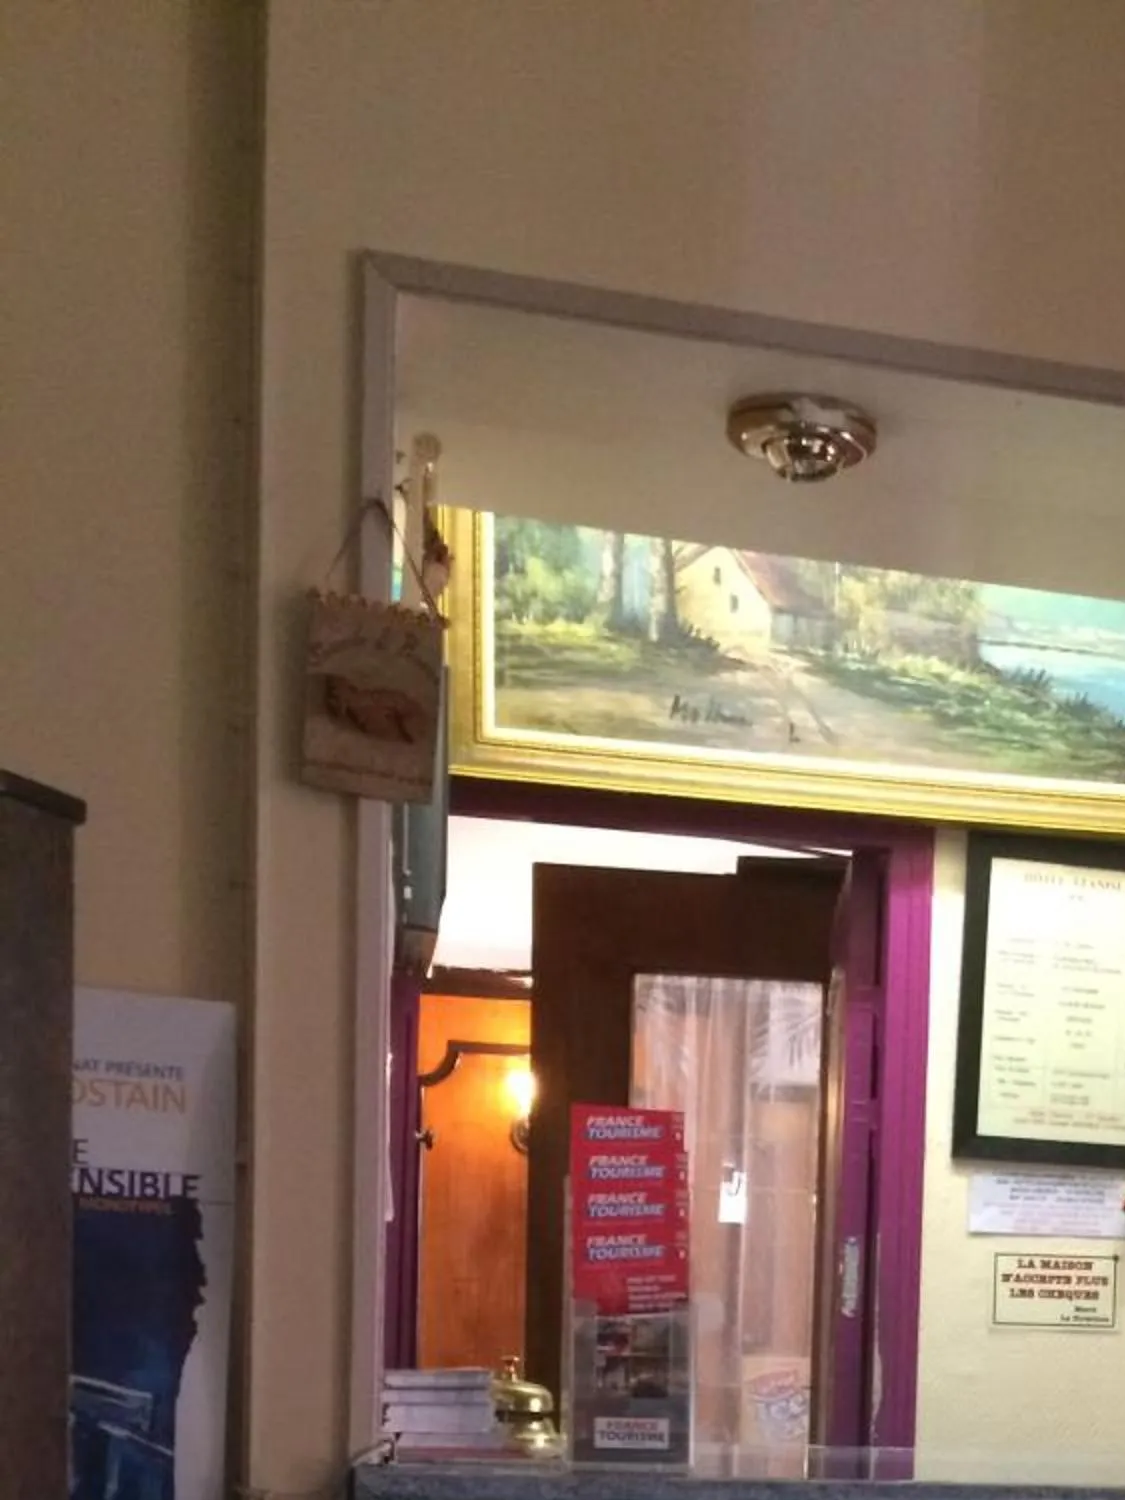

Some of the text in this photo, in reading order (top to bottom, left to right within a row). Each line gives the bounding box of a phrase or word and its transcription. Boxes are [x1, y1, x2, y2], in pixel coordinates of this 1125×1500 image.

[587, 1115, 644, 1127] FRANCE
[588, 1155, 648, 1167] FRANCE
[587, 1191, 648, 1204] FRANCE
[586, 1233, 647, 1247] FRANCE
[1017, 1258, 1094, 1272] LA MAISON
[1009, 1288, 1035, 1299] LES
[606, 1419, 658, 1431] FRANCE
